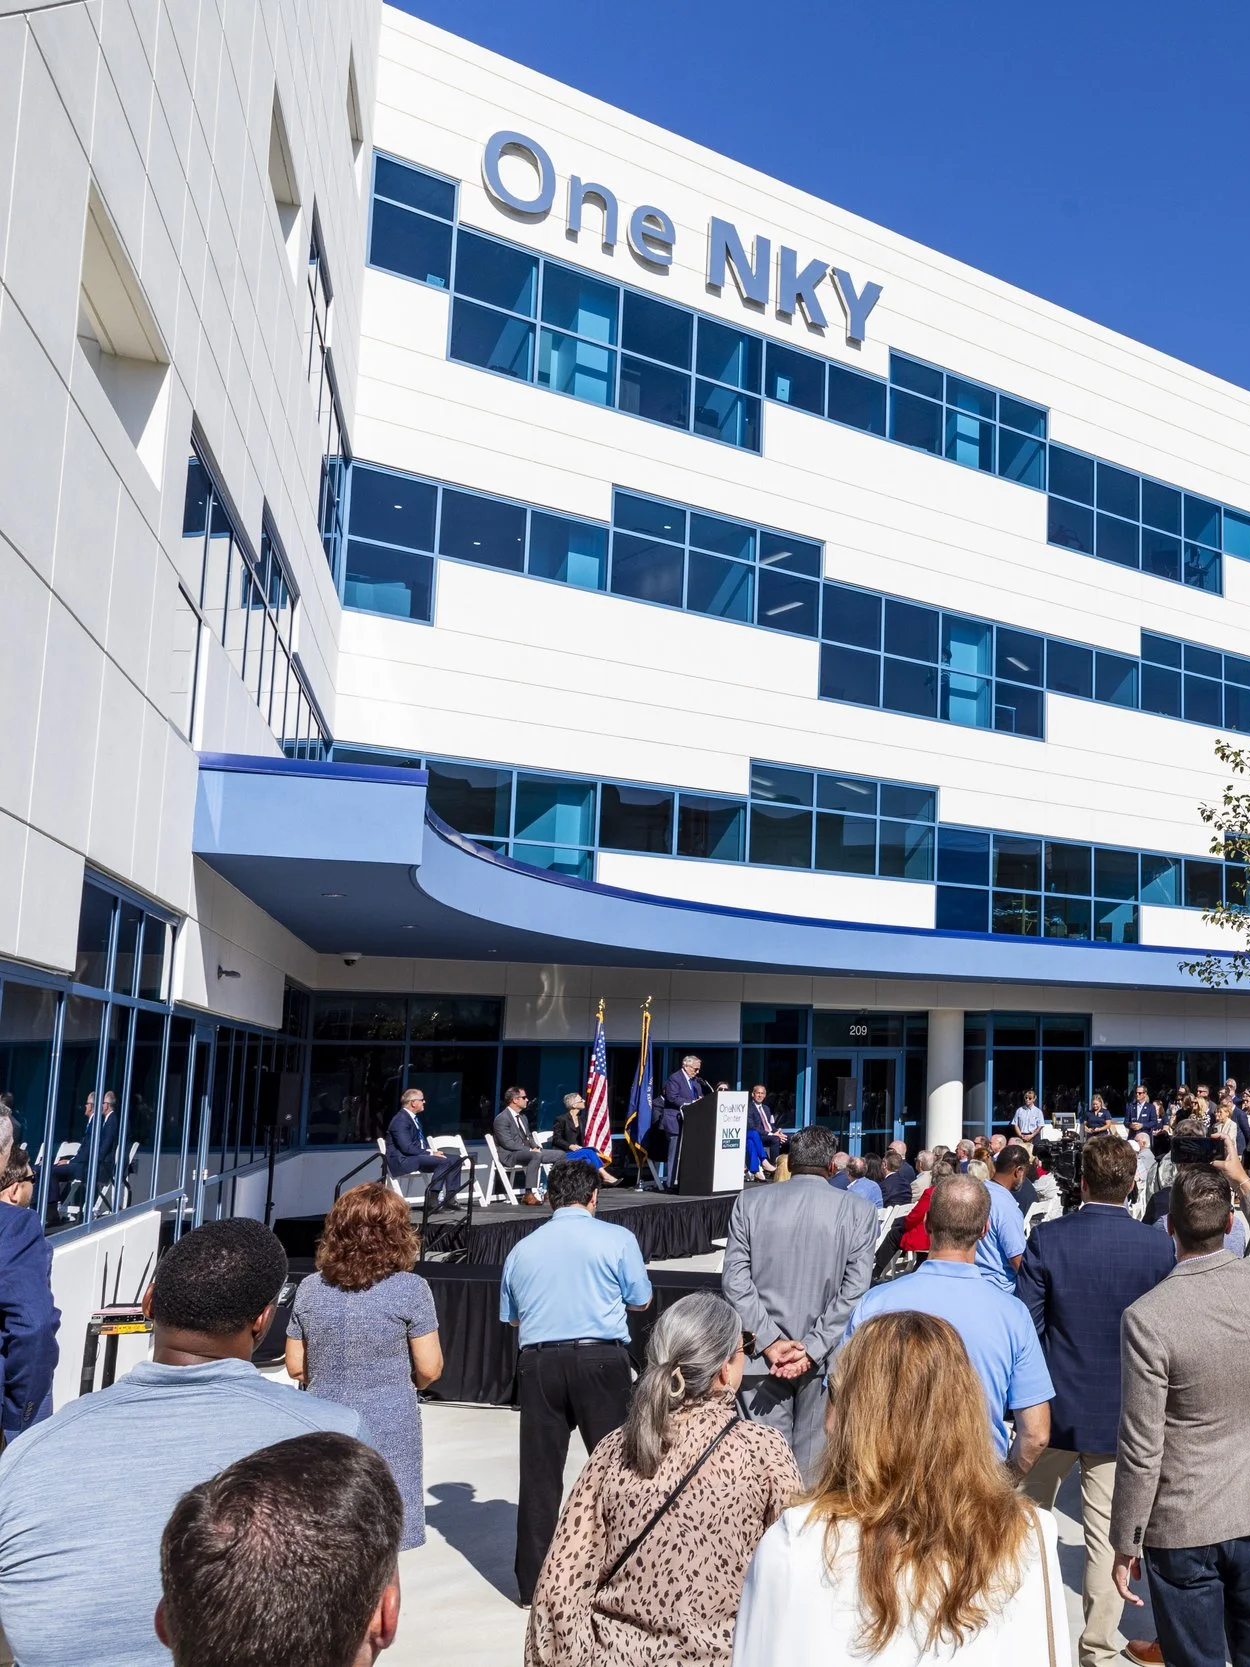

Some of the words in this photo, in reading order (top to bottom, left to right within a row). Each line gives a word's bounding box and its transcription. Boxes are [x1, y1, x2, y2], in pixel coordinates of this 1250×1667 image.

[481, 130, 676, 267] One
[706, 216, 884, 343] NKY
[849, 1025, 868, 1036] 209
[722, 1127, 741, 1139] NKY
